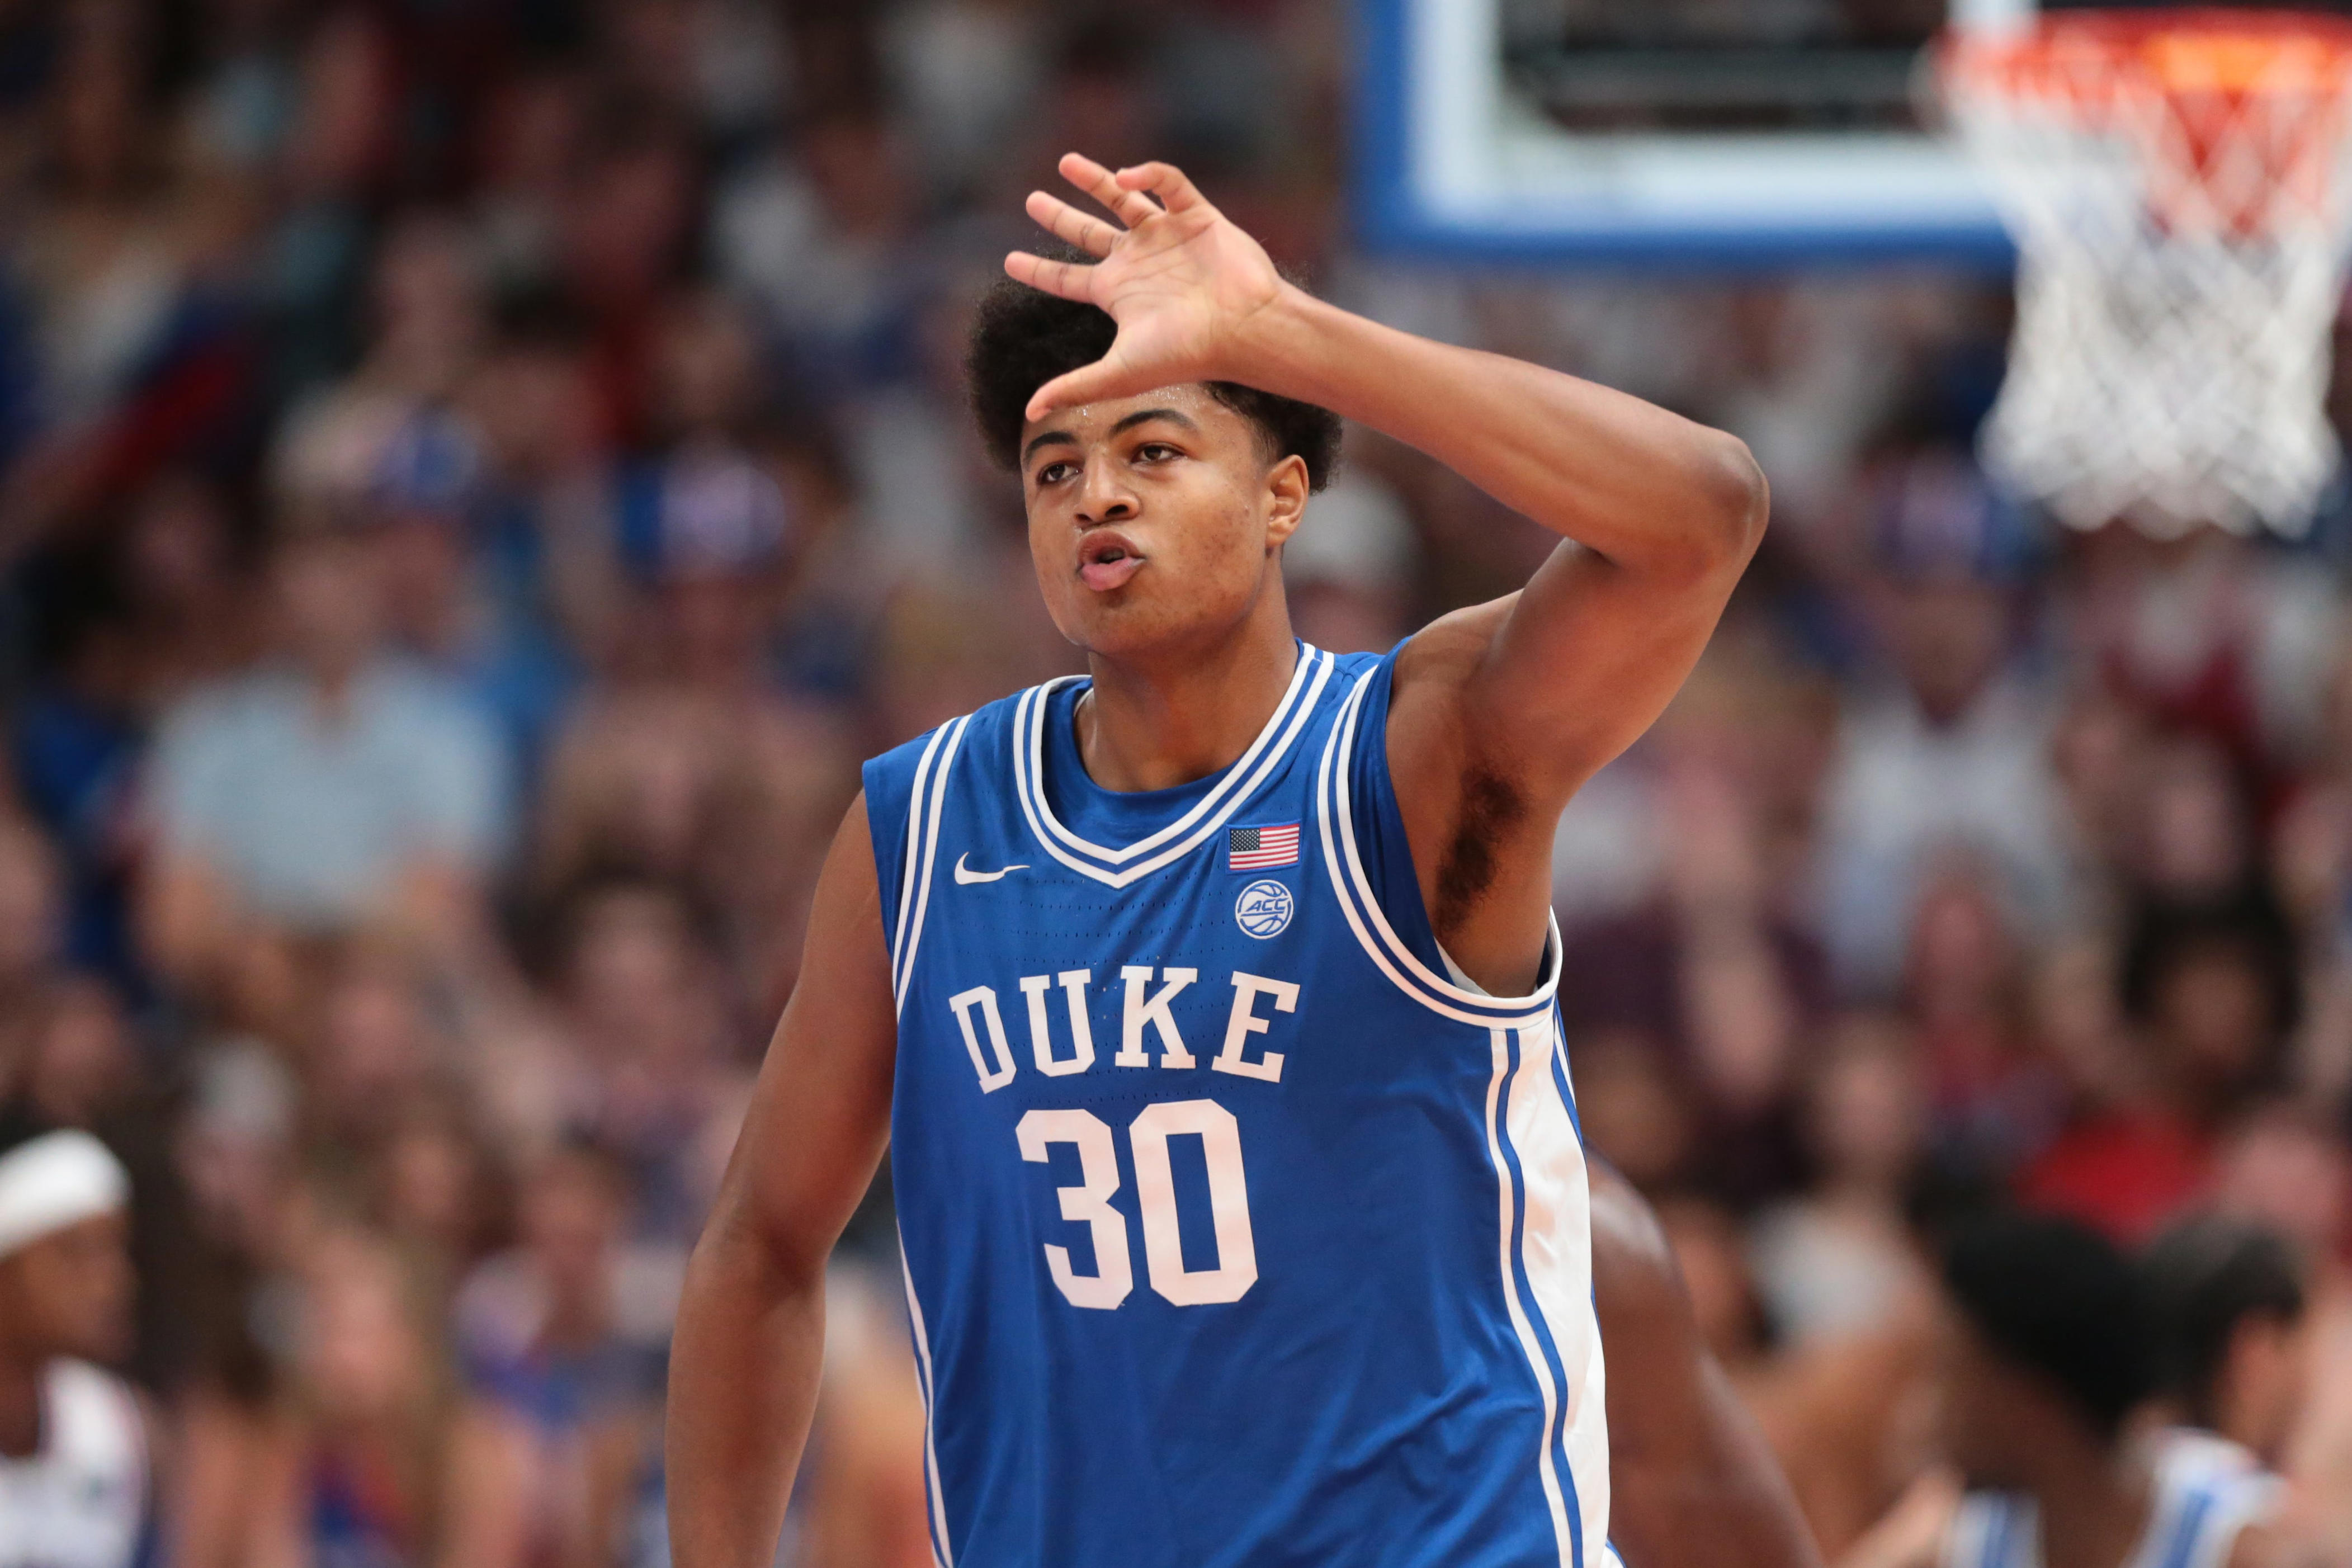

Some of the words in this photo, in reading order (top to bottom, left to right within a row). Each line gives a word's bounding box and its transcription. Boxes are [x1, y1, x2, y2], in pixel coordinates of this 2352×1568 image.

[1246, 898, 1288, 911] ACC
[948, 965, 1300, 1095] DUKE
[1015, 1098, 1258, 1310] 30
